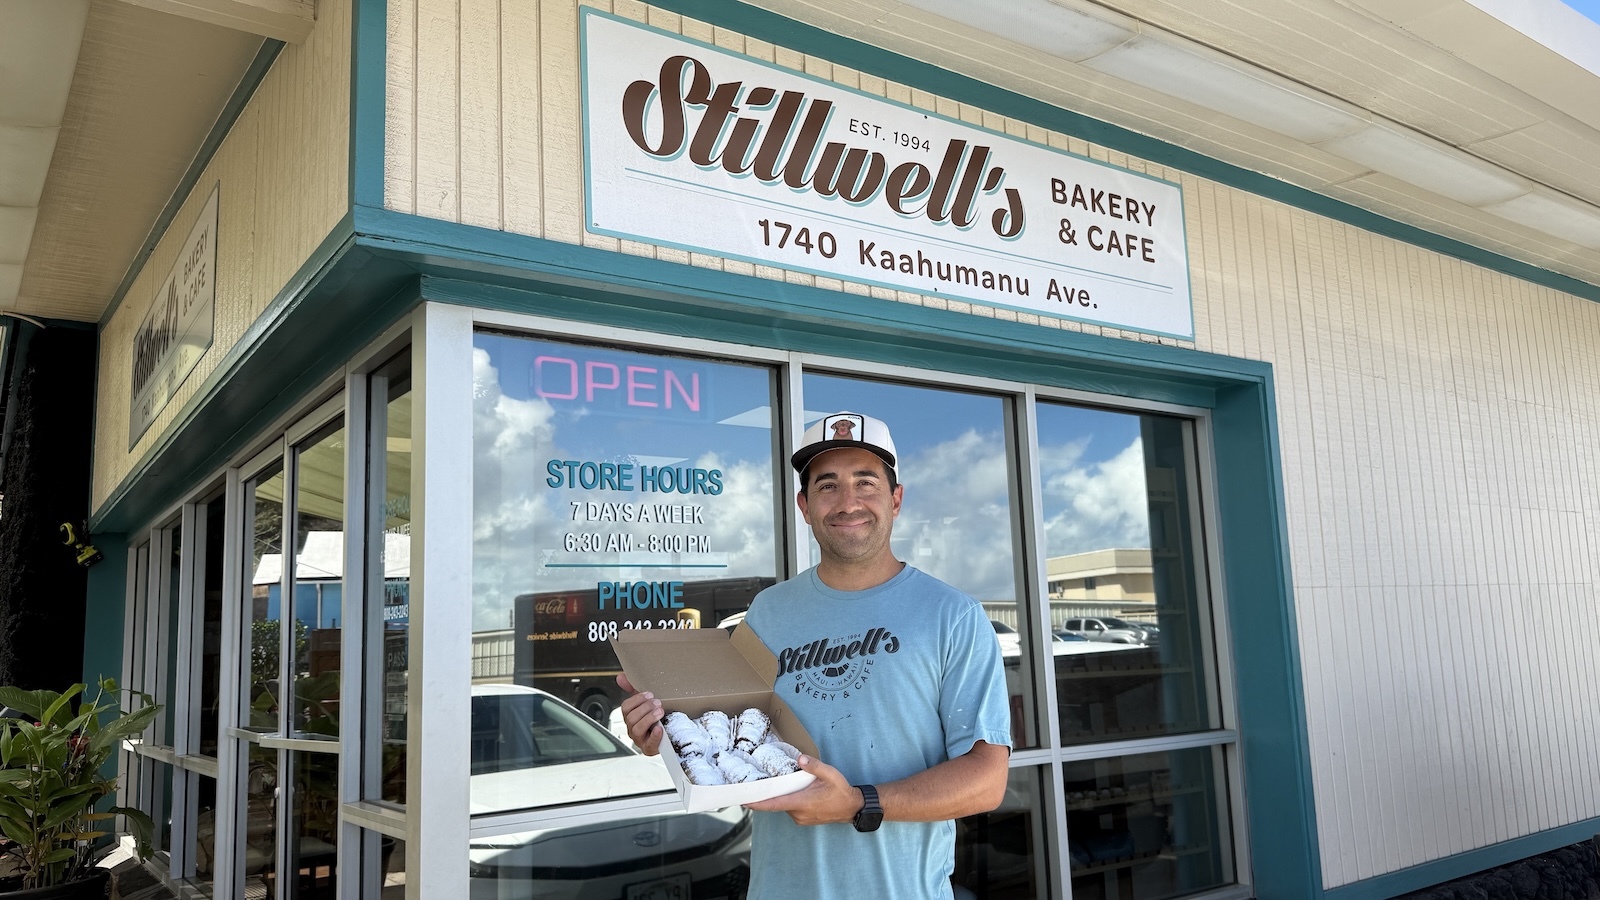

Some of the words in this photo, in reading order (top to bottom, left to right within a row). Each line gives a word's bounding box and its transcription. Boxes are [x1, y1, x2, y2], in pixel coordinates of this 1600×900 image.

[622, 55, 1026, 239] Stillwell's
[848, 117, 887, 142] EST.
[892, 130, 932, 154] 1994
[1050, 177, 1158, 228] BAKERY
[183, 223, 209, 286] BAKERY
[757, 218, 838, 260] 1740
[857, 239, 1031, 297] Kaahumanu
[1045, 278, 1099, 309] Ave.
[1057, 218, 1078, 247] &
[1086, 225, 1157, 264] CAFE
[189, 262, 206, 307] CAFE
[533, 355, 700, 412] OPEN
[546, 459, 635, 492] STORE
[641, 465, 724, 496] HOURS
[570, 501, 582, 521] 7
[586, 502, 635, 523] DAYS
[637, 503, 651, 523] A
[654, 504, 705, 525] WEEK
[563, 532, 601, 552] 6:30
[604, 533, 634, 552] AM
[648, 534, 683, 553] 8:00
[686, 535, 711, 554] PM
[597, 580, 685, 610] PHONE
[777, 627, 900, 678] Stillwell's
[795, 673, 836, 701] BAKERY
[843, 691, 850, 699] &
[854, 658, 874, 690] CAFE
